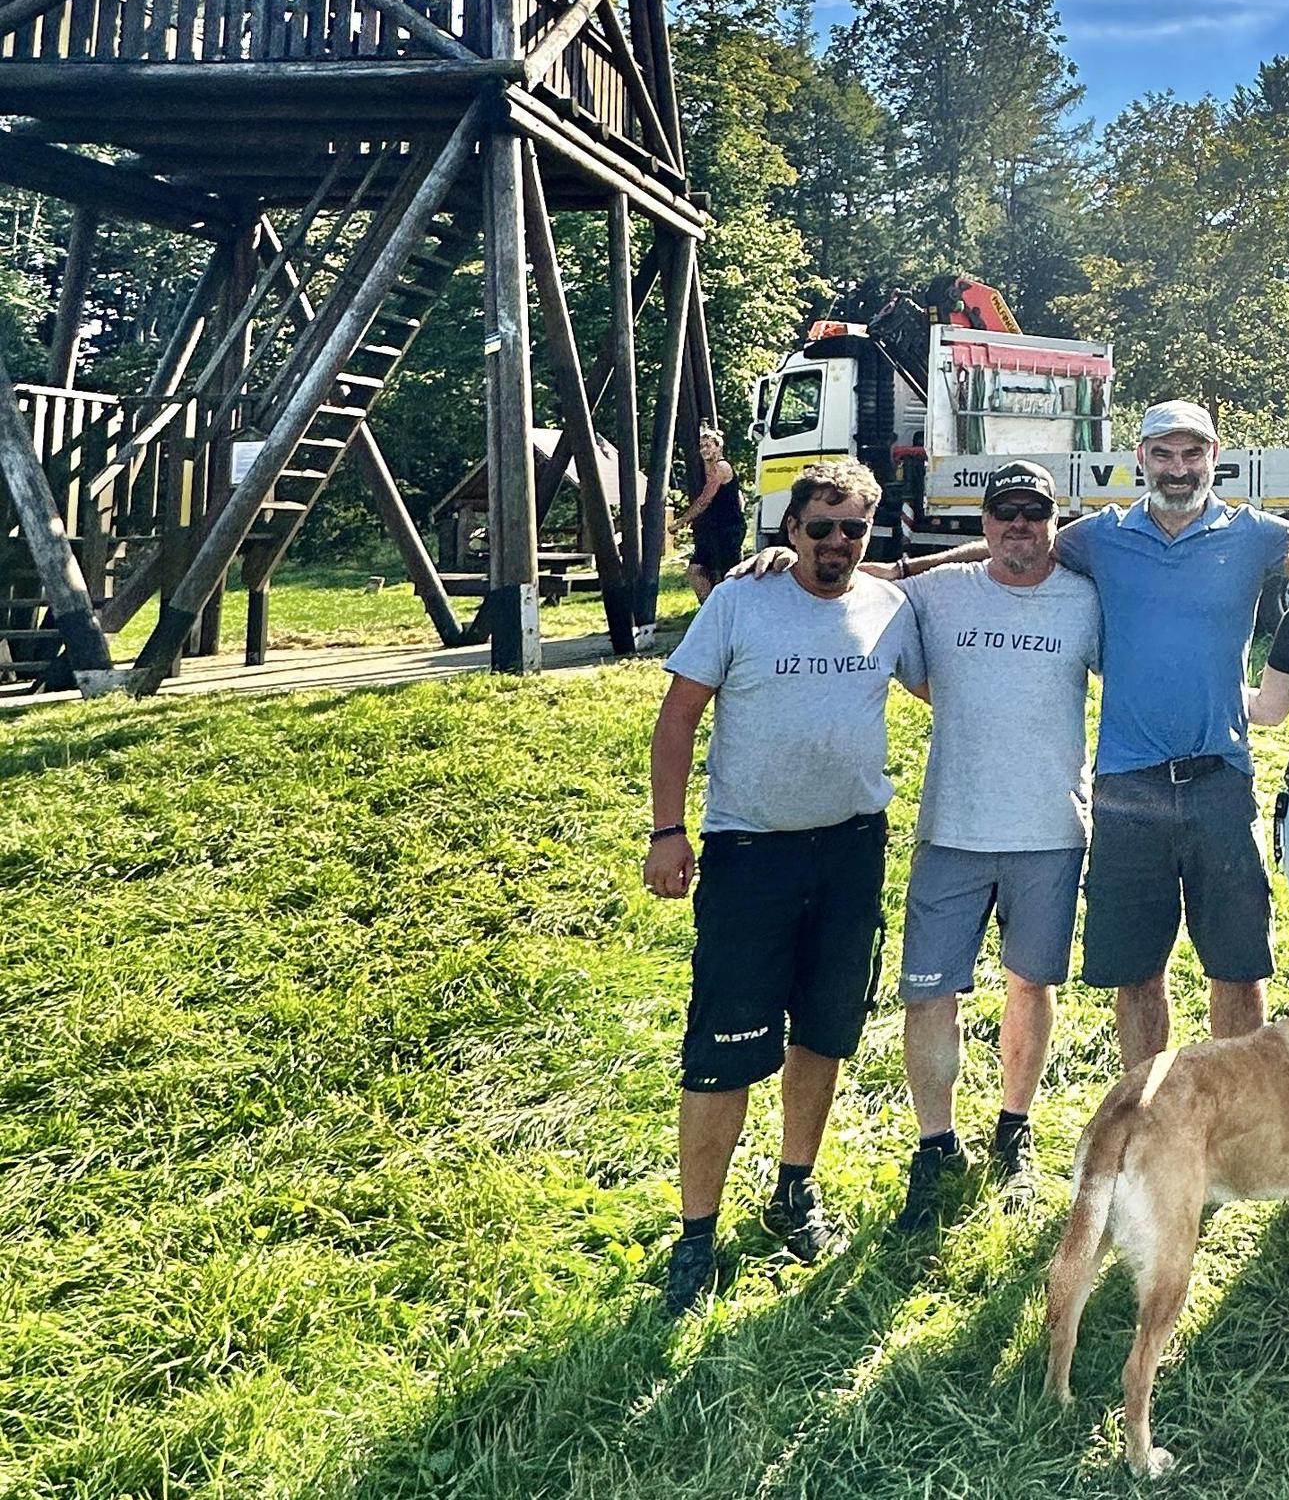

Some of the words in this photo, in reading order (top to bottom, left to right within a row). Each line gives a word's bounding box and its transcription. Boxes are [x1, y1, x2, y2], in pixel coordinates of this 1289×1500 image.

[956, 627, 978, 647] UŽ
[984, 632, 1005, 648] TO
[1011, 634, 1062, 654] VEZU!
[775, 653, 801, 675] UŽ
[807, 657, 828, 675] TO
[714, 1026, 769, 1043] VASTAP
